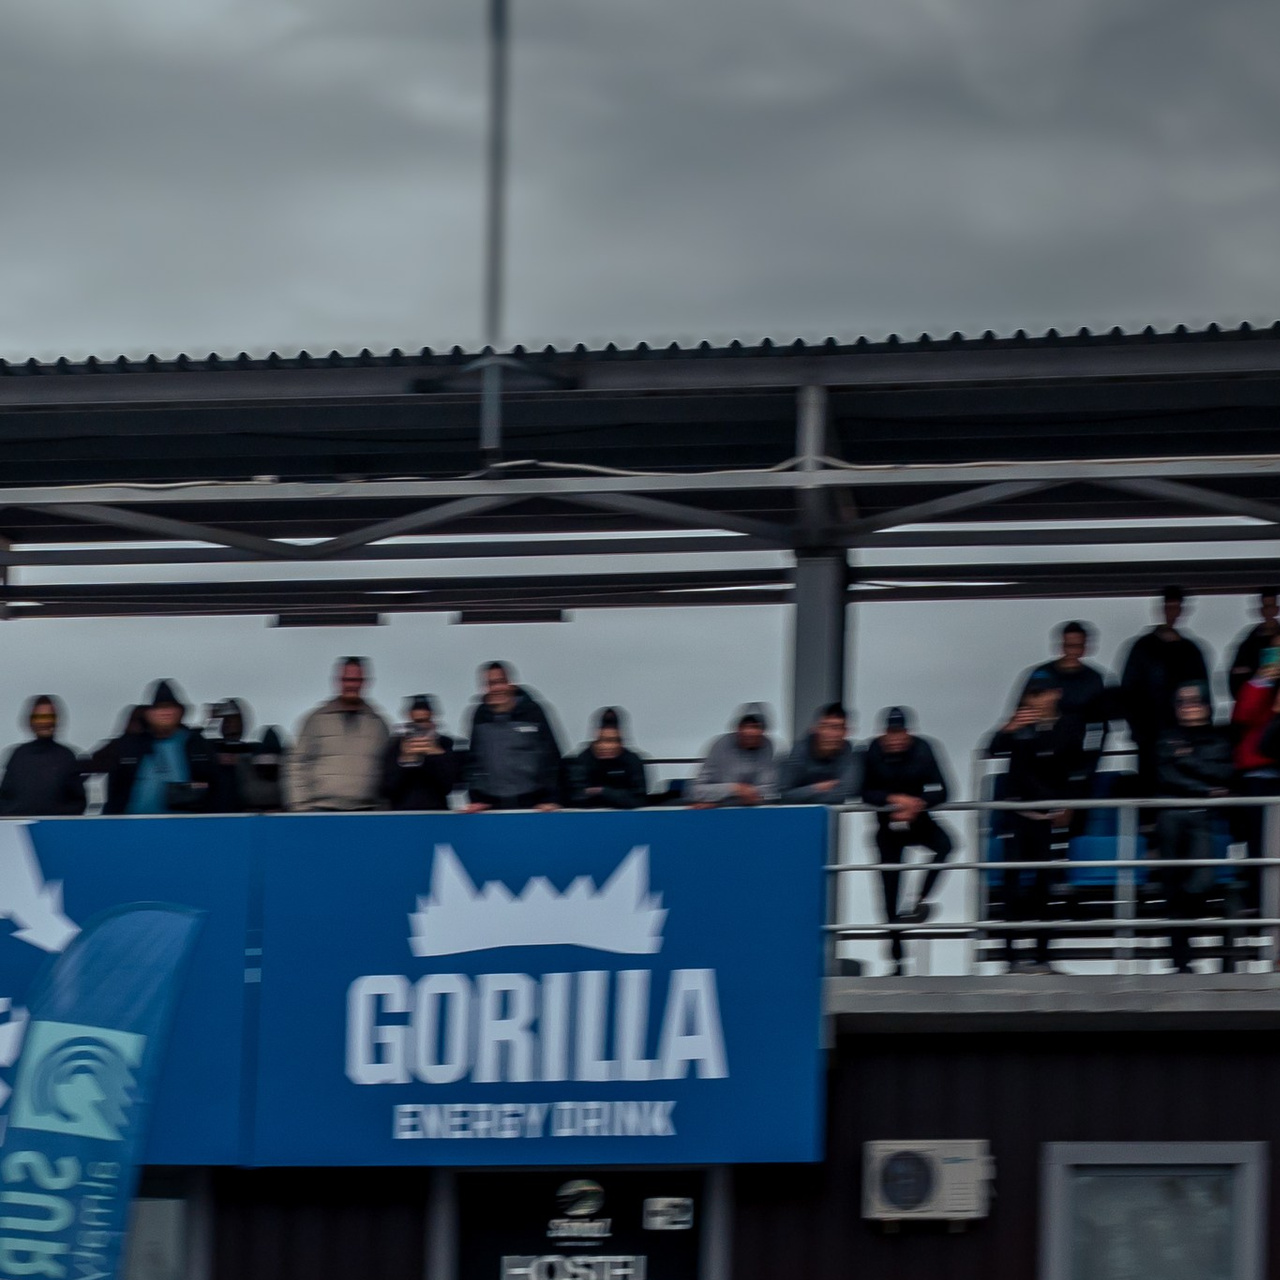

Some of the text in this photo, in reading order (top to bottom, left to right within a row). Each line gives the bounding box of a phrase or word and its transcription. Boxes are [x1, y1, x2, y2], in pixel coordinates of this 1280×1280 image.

[345, 968, 730, 1084] GORILLA
[392, 1101, 678, 1140] ENERGY DRINK
